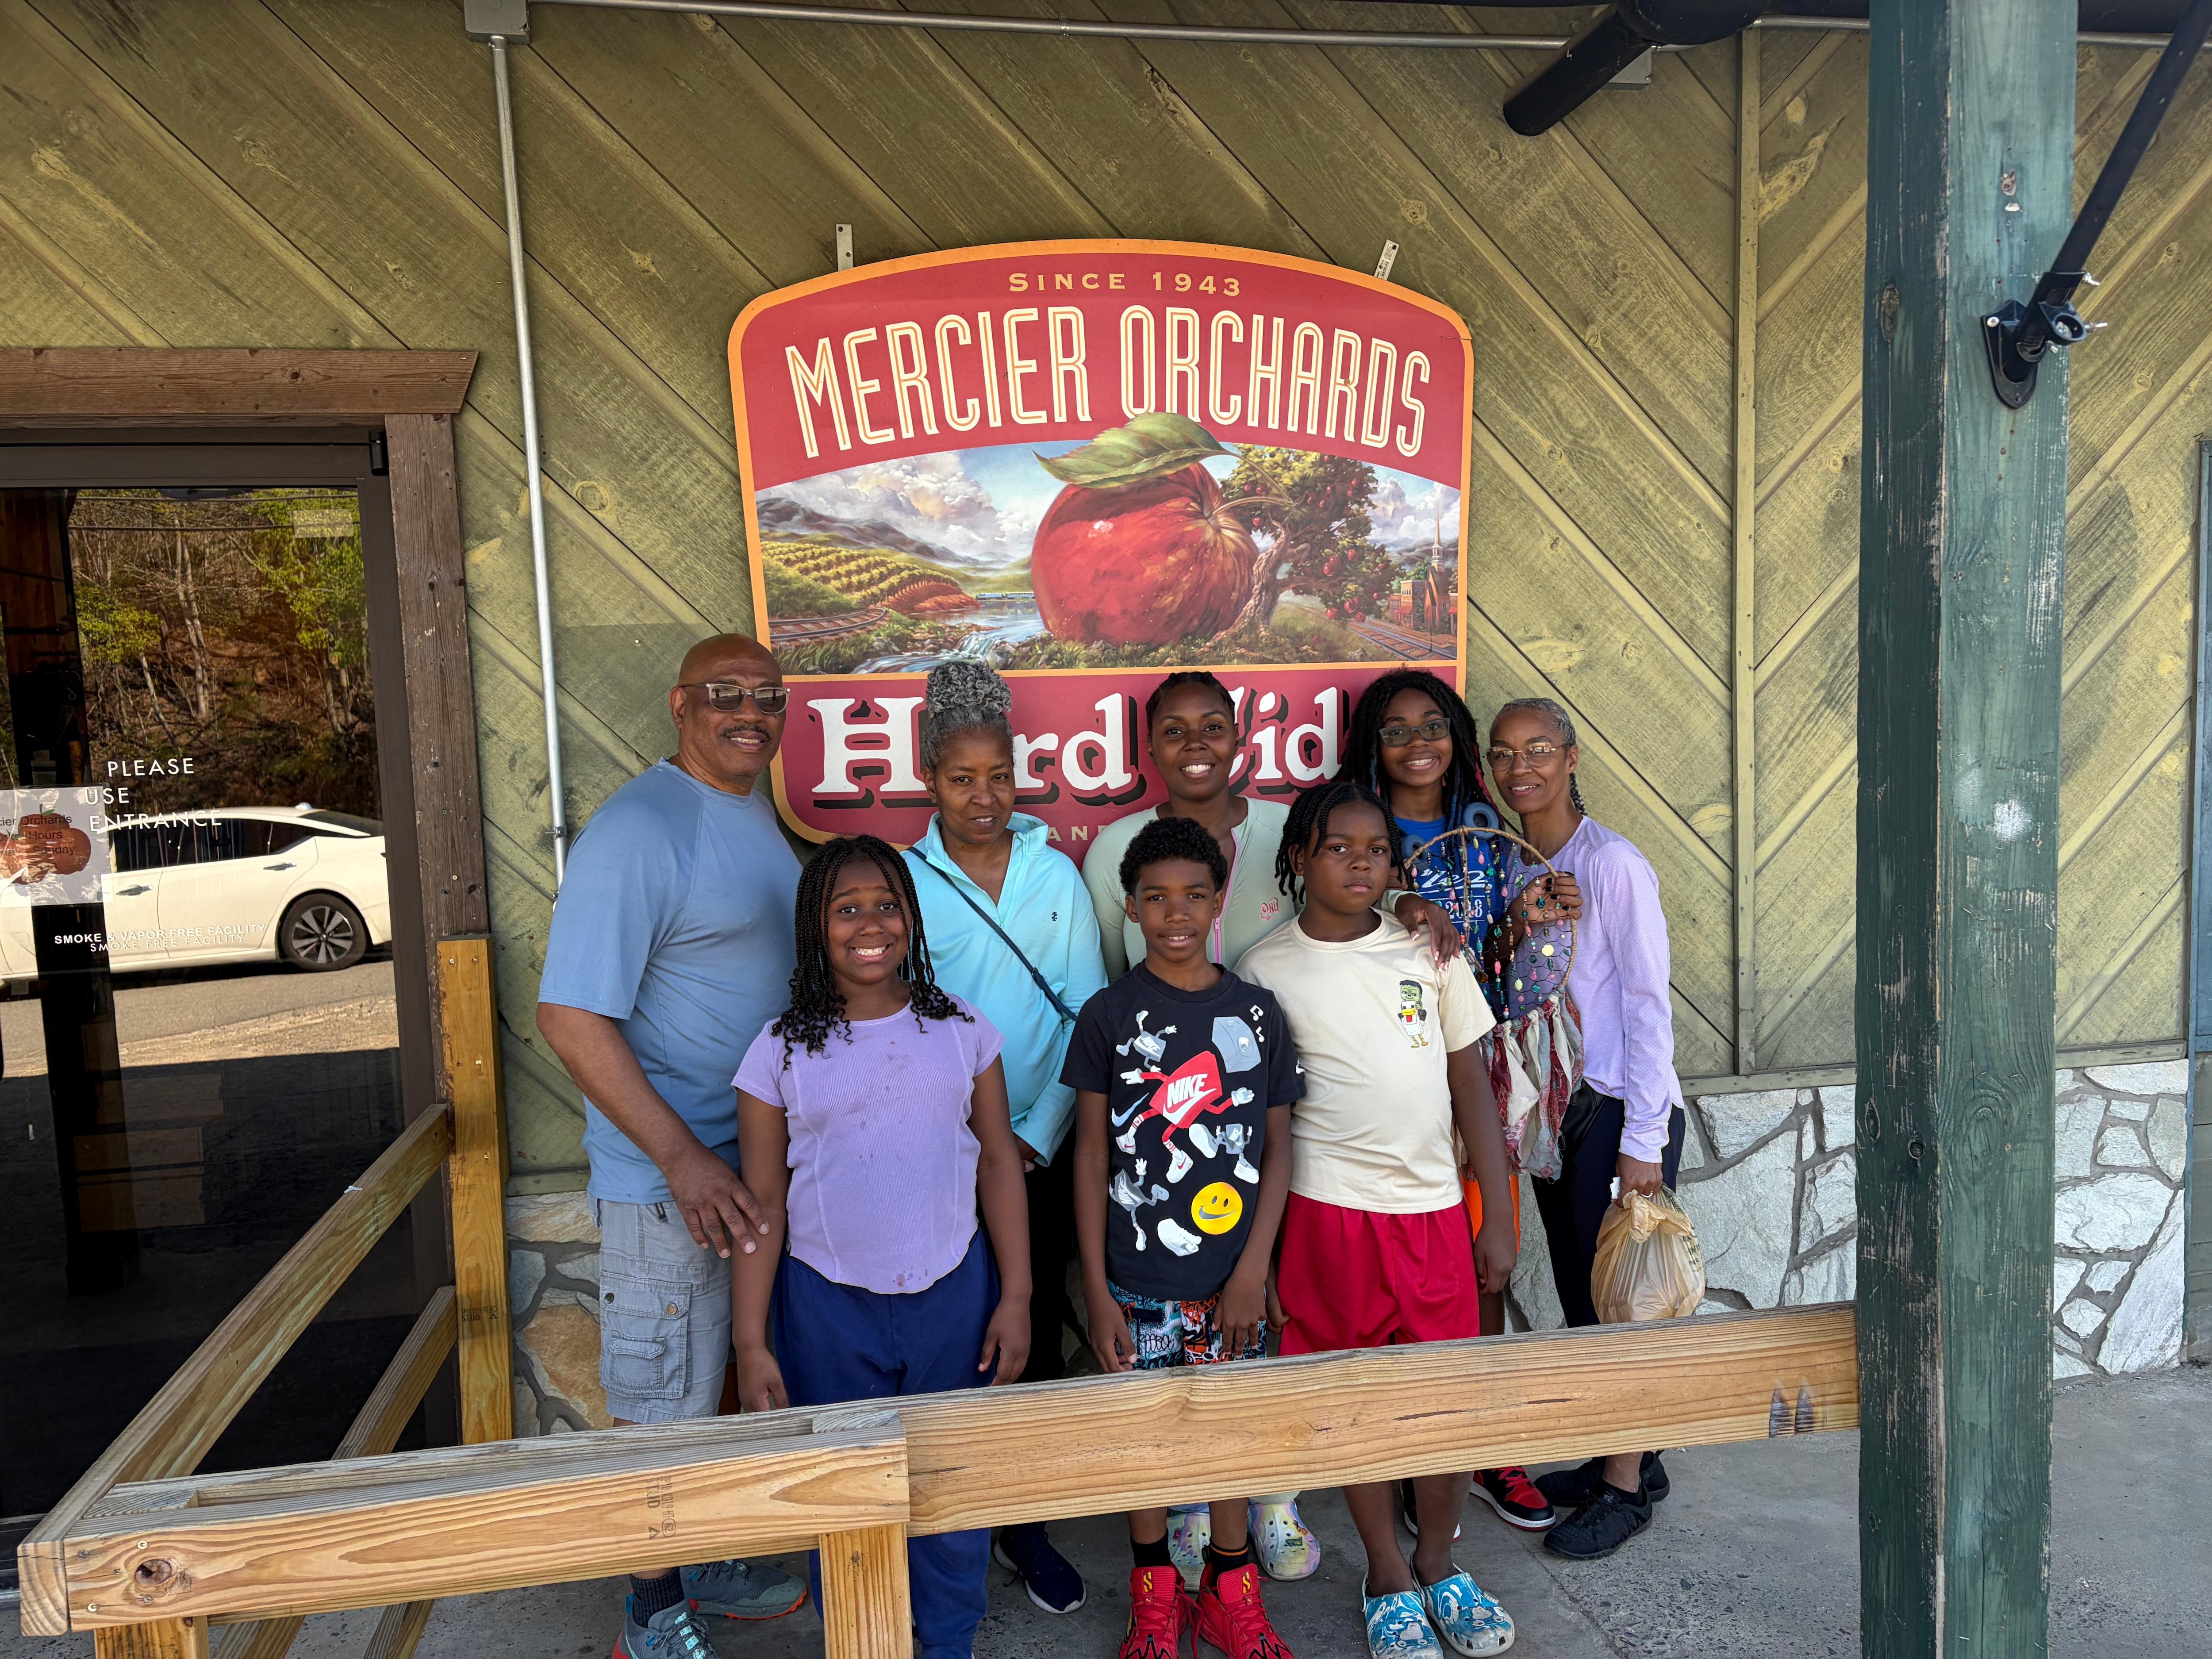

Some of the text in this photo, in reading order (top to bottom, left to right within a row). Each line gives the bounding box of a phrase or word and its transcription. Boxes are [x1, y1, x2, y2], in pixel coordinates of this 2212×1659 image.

[1009, 271, 1240, 296] SINCE 1943
[785, 304, 1430, 458] MERCIER ORCHARDS
[807, 686, 1342, 793] Hrd id
[108, 758, 194, 777] PLEASE
[84, 787, 129, 805] USE
[20, 814, 73, 826] Orchards
[89, 810, 222, 832] ENTRANCE
[29, 831, 62, 840] Hours
[1046, 825, 1110, 841] AN
[32, 845, 76, 856] Snday
[54, 923, 265, 944] SMOKE & VAPOR FREE FACILITY
[90, 934, 244, 952] SMOKE FREE FACILITY
[1167, 1073, 1208, 1109] NIKE
[664, 1523, 675, 1532] 62
